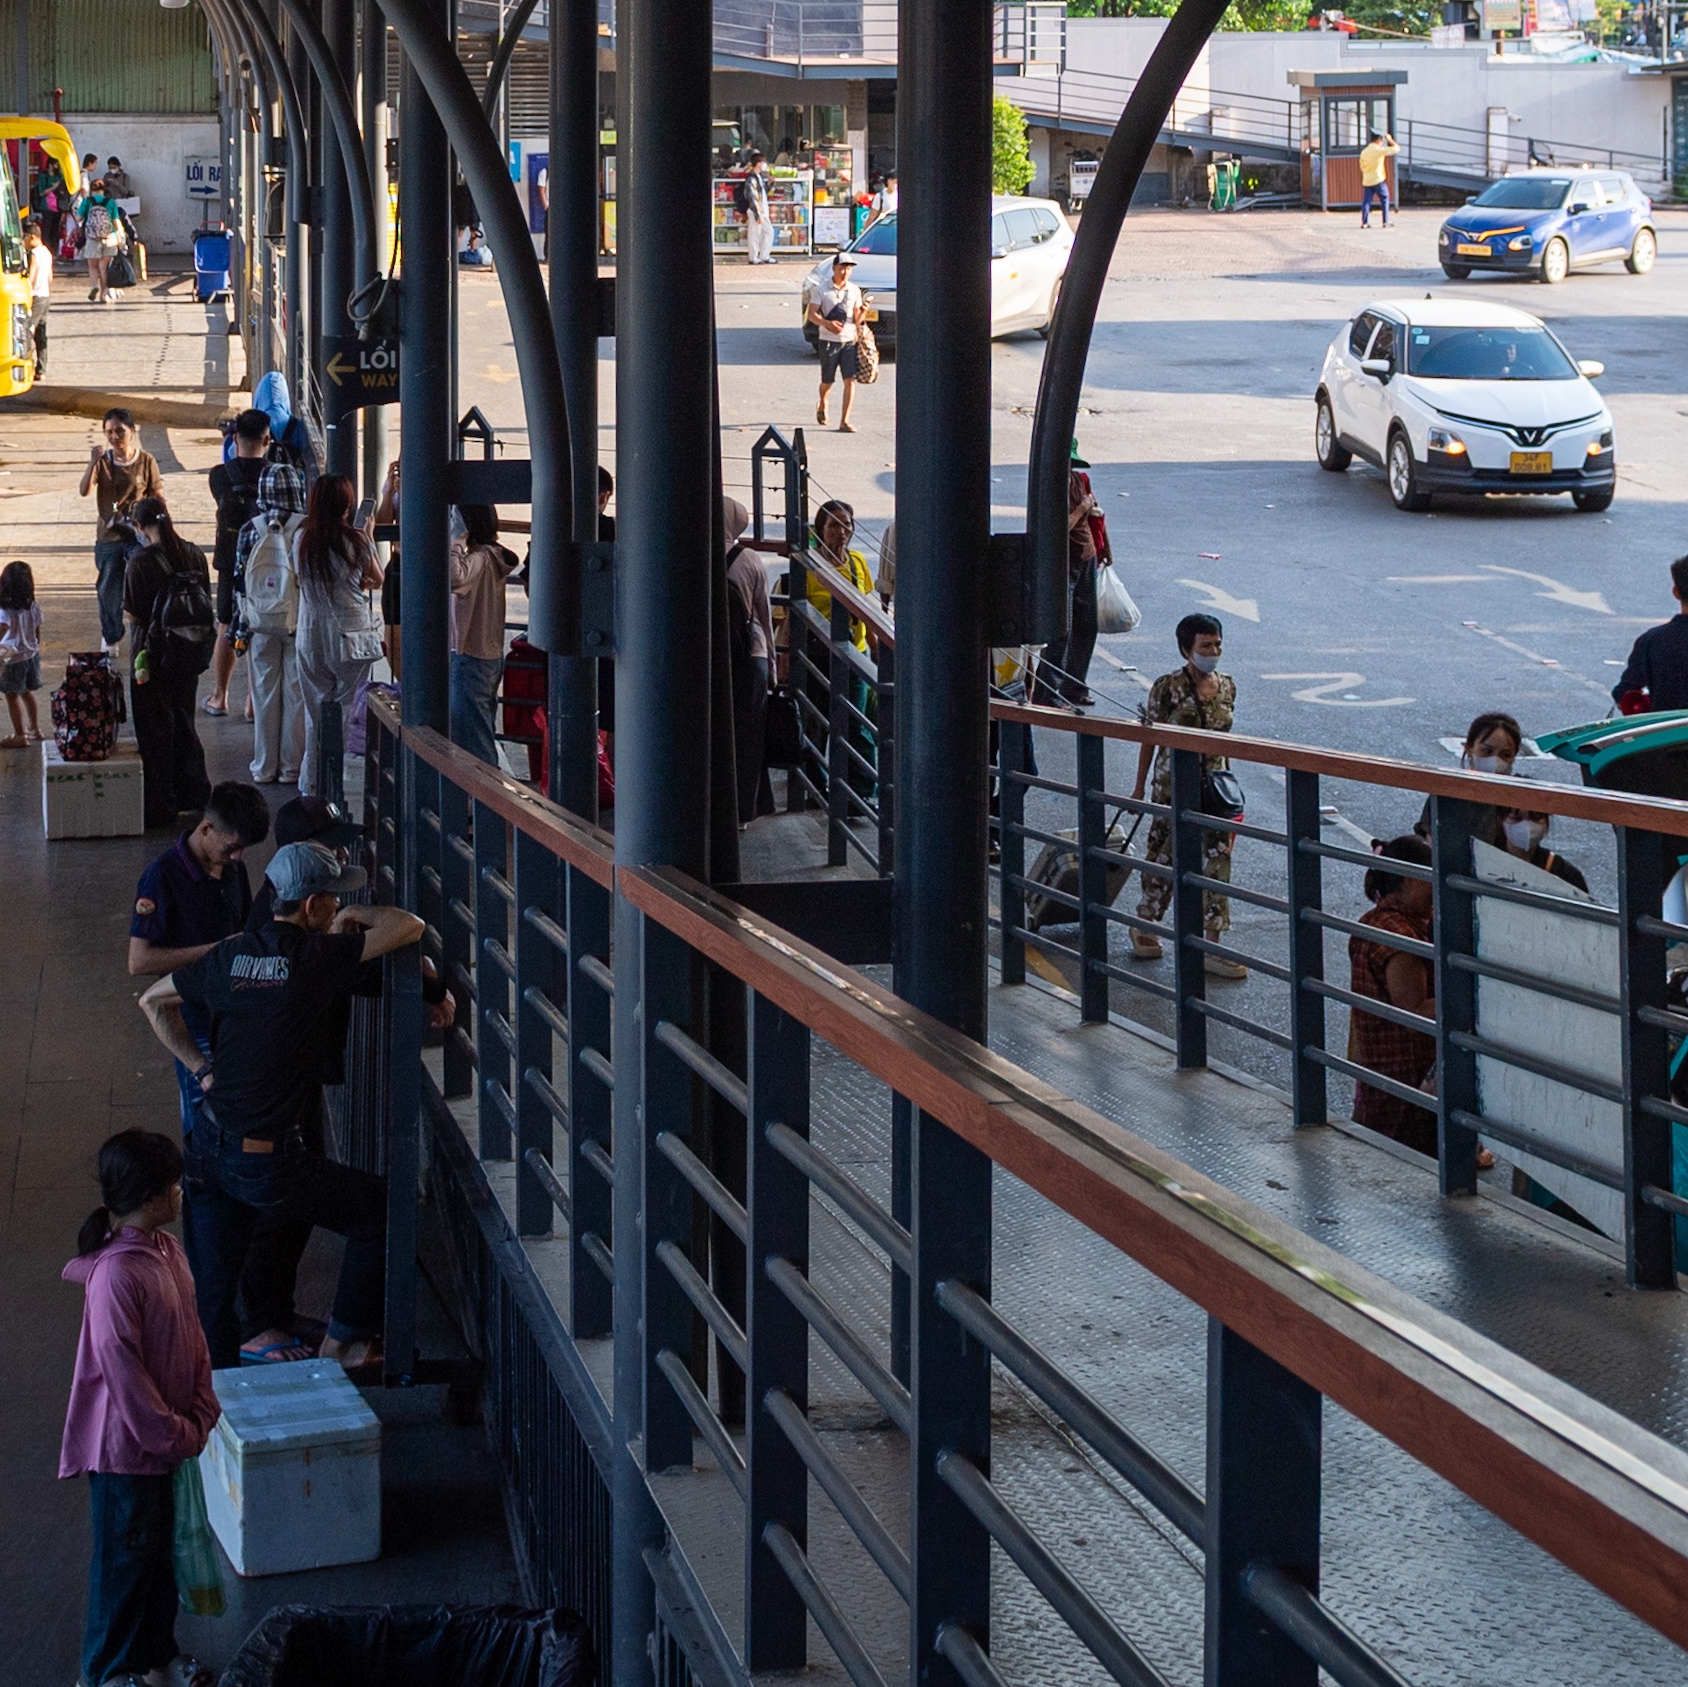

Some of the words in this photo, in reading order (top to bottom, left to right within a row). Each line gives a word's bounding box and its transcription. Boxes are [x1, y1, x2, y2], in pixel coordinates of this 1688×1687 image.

[186, 159, 203, 181] LỐI
[360, 339, 396, 370] LỐI
[361, 373, 398, 388] WAY
